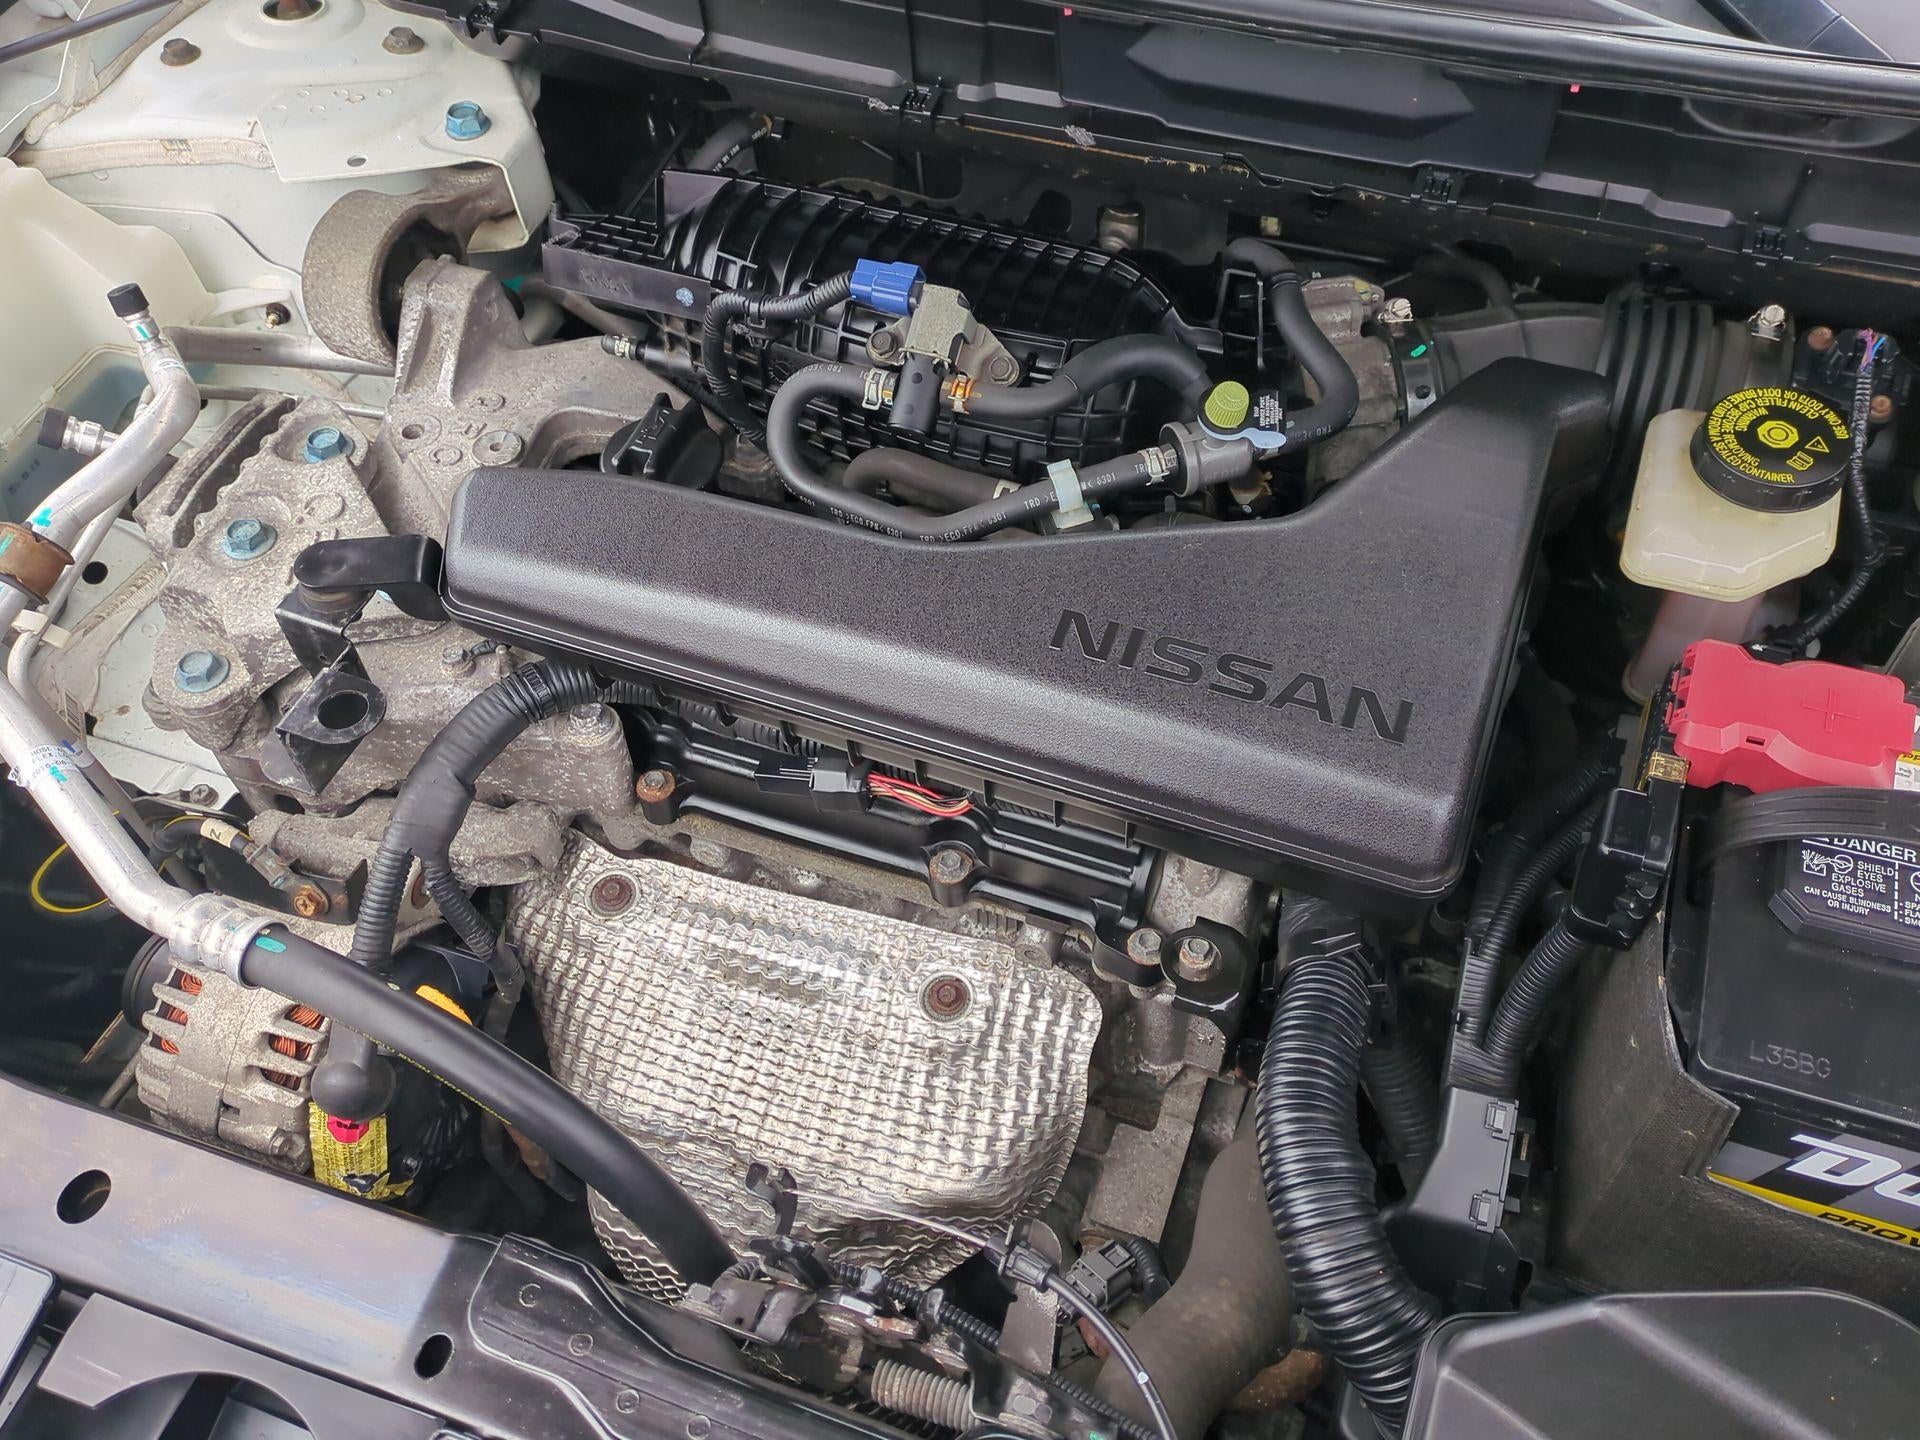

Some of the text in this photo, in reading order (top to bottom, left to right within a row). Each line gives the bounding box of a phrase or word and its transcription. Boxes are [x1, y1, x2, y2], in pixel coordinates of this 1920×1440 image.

[1727, 389, 1757, 405] BRAKE
[1757, 388, 1782, 398] DOT4
[1784, 390, 1798, 400] OR
[1799, 393, 1823, 411] DOT3
[1712, 400, 1733, 417] FLUID
[1820, 407, 1841, 427] ONLY
[1708, 416, 1721, 435] FROM
[1735, 407, 1768, 431] WARNING
[1721, 397, 1819, 466] CLEAN FILLER CAP BEFORE REMOVING
[1834, 425, 1849, 439] USE
[1713, 441, 1741, 466] SEALED
[1740, 463, 1795, 483] CONTAINER
[1023, 497, 1040, 510] TRD
[1049, 608, 1414, 745] NISSAN
[1833, 837, 1917, 863] DANGER
[1857, 861, 1895, 876] SHIELD
[1857, 870, 1883, 883] EYES
[1831, 873, 1887, 893] EXPLOSIVE
[1831, 883, 1864, 897] GASES
[1804, 885, 1892, 913] CAN CAUSE BLINDNESS
[1827, 899, 1870, 916] OR INJURY
[1750, 1039, 1832, 1078] L35BG
